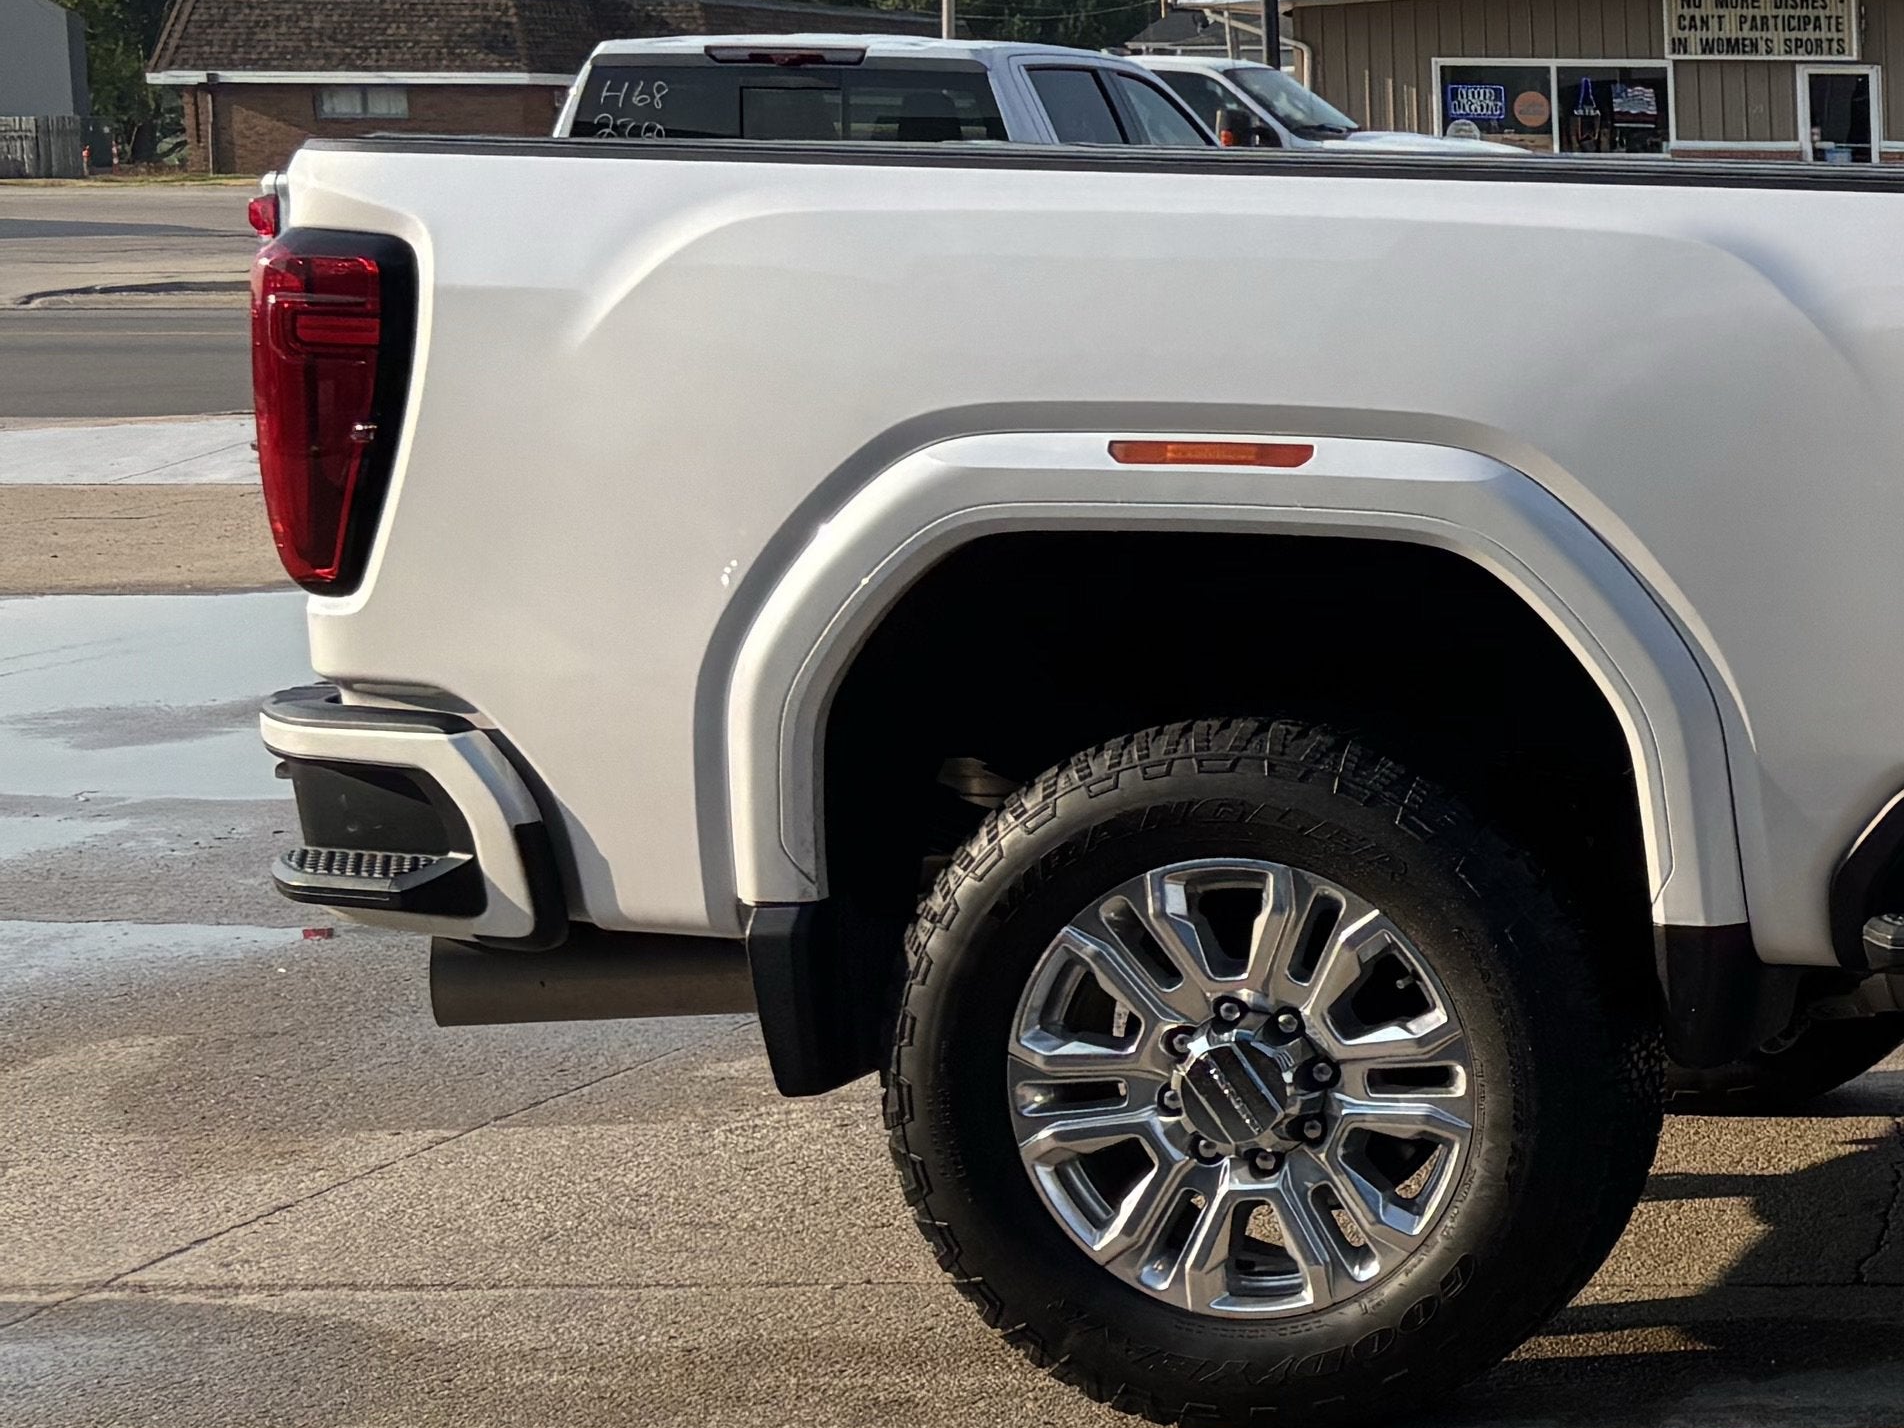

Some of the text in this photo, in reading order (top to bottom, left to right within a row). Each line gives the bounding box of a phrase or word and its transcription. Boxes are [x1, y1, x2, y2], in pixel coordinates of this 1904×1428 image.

[1677, 13, 1845, 33] CAN'T PARTICIPATE
[1671, 35, 1847, 55] IN WOMEN'S SPORTS
[600, 79, 669, 109] H68
[989, 797, 1409, 924] WRANGLER
[1048, 1252, 1478, 1386] GOODYEAR
